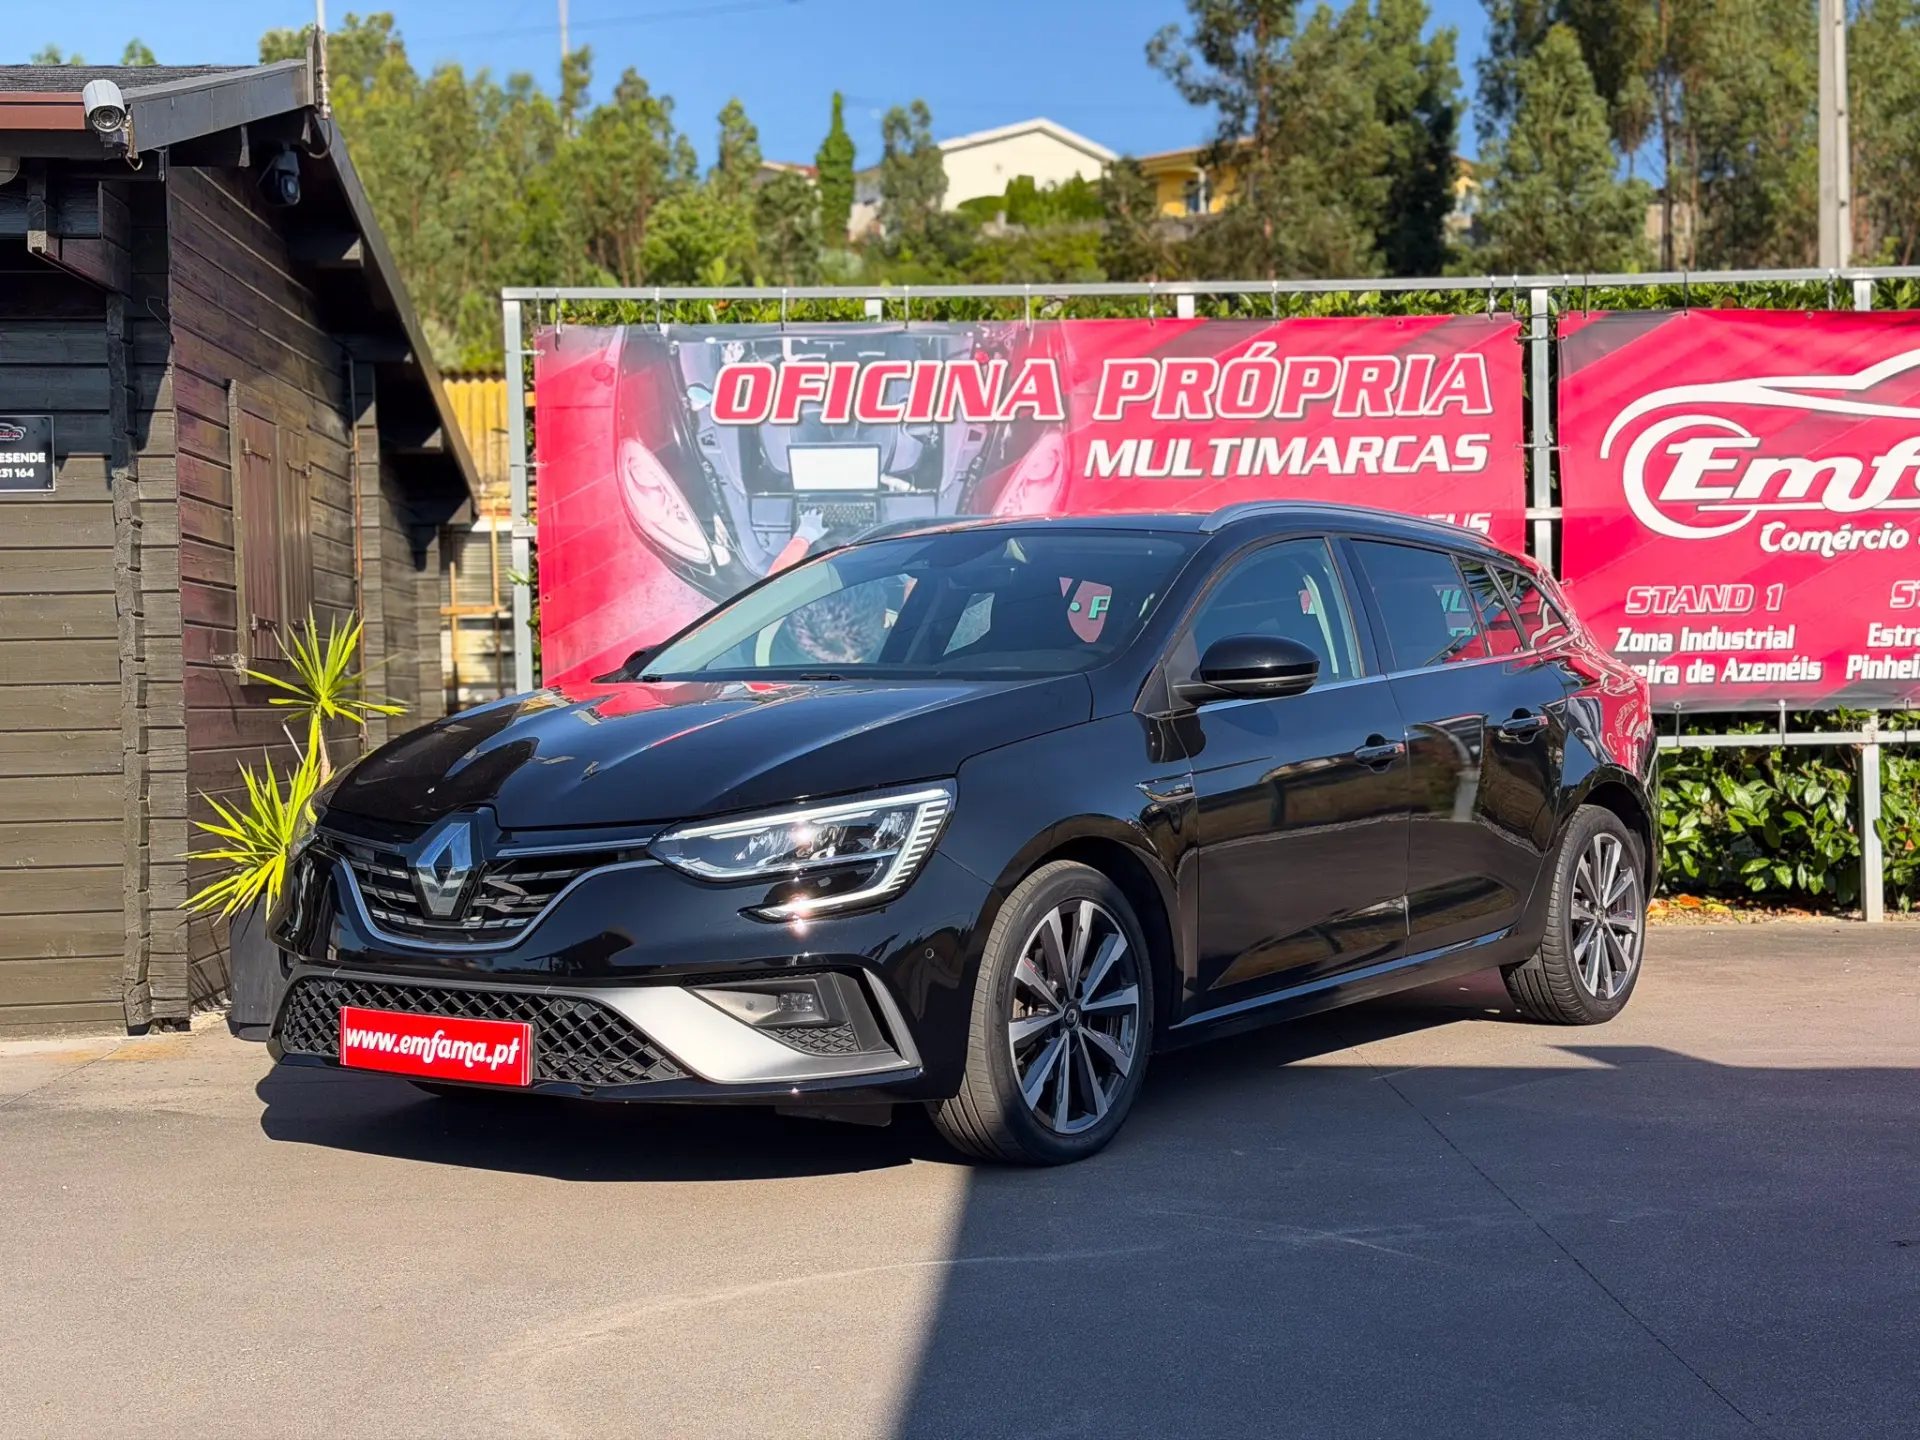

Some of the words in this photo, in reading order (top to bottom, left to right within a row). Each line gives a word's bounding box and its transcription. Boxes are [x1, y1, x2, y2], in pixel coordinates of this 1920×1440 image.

[710, 359, 1066, 425] OFICINA
[1093, 341, 1493, 420] PRÓPRIA
[14, 467, 35, 478] 164
[1084, 433, 1491, 477] MULTIMARCAS
[1658, 436, 1920, 512] Emf
[1760, 522, 1909, 557] Comércio
[1625, 584, 1754, 614] STAND
[1766, 583, 1783, 611] 1
[1614, 627, 1673, 652] Zona
[1680, 624, 1796, 651] Industrial
[1686, 659, 1715, 684] de
[1721, 655, 1822, 683] Azeméis
[346, 1027, 519, 1071] www.emfama.pt
